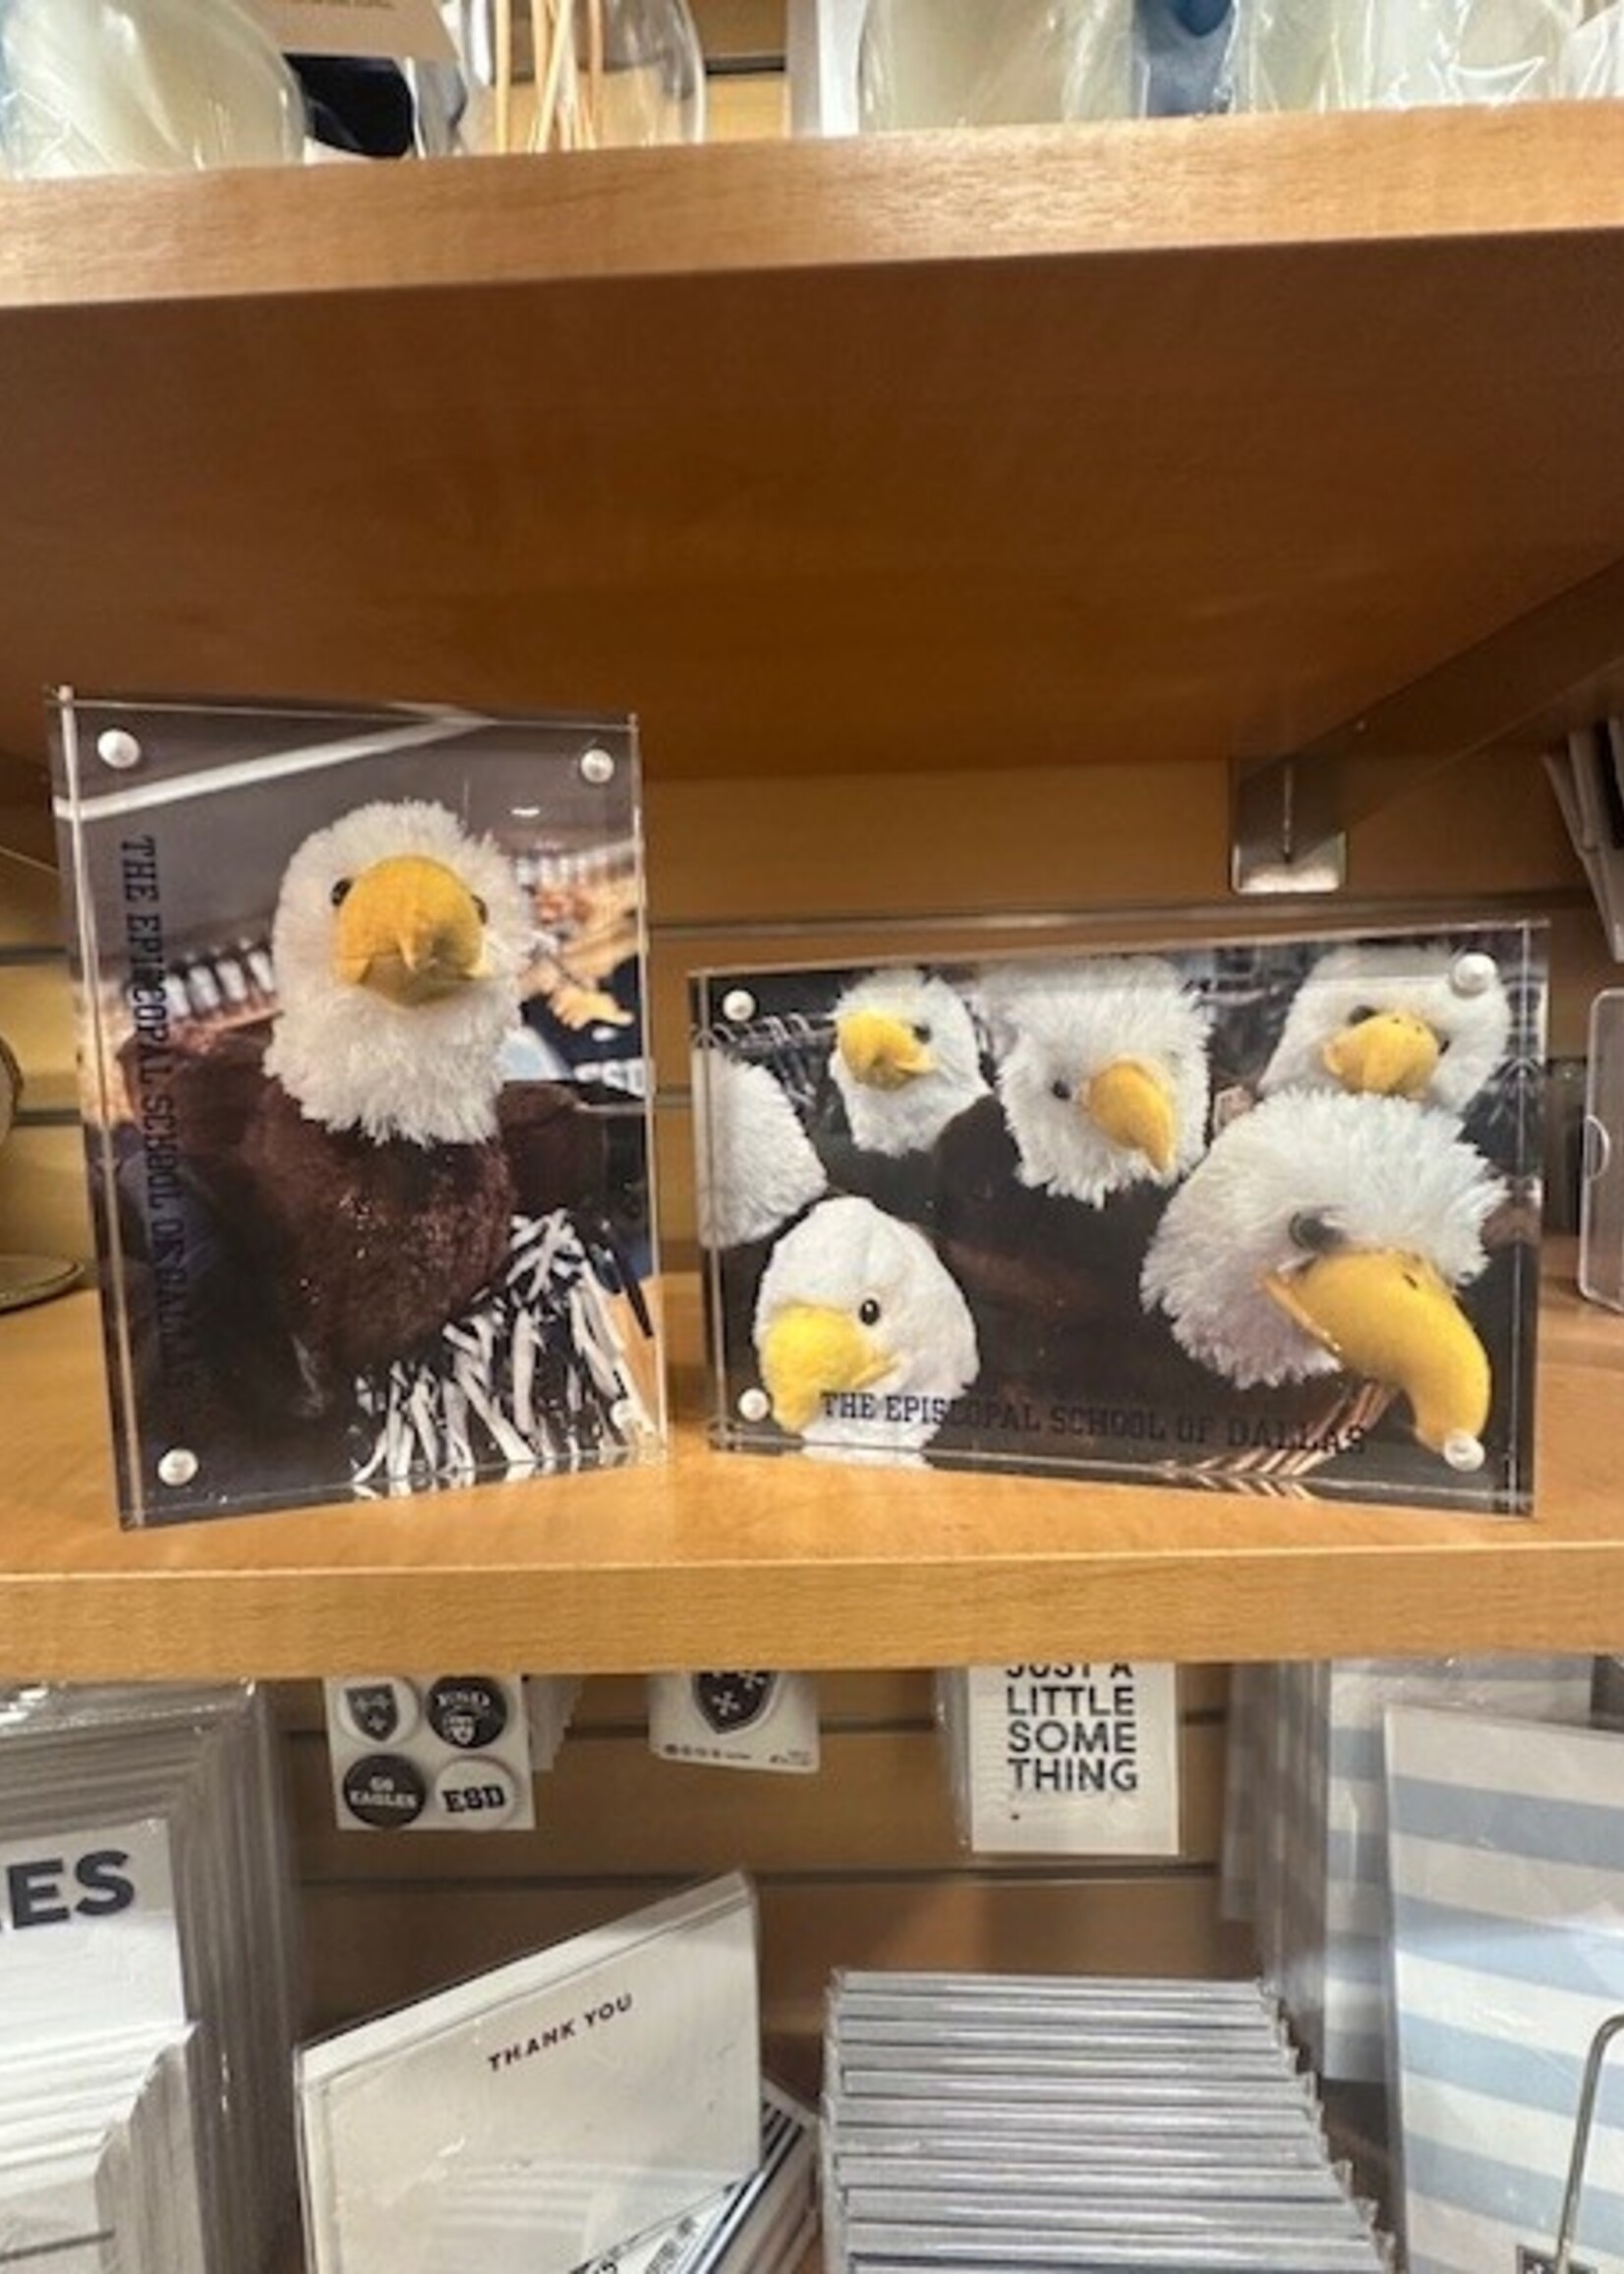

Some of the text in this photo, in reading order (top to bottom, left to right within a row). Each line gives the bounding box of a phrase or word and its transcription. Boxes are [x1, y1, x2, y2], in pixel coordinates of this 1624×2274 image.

[121, 836, 159, 904] THE
[126, 913, 172, 1084] EPISCOPAL
[142, 1092, 182, 1209] SCHOOL
[819, 1390, 1365, 1454] THE EPISCOPAL SCHOOL OF DALLAS
[1007, 1685, 1135, 1717] LITTLE
[1007, 1720, 1137, 1754] SOME
[349, 1790, 418, 1810] EAGLES
[442, 1785, 505, 1814] ESD
[1007, 1757, 1138, 1792] THING
[0, 1850, 135, 1933] ES
[489, 1992, 633, 2072] THANK YOU
